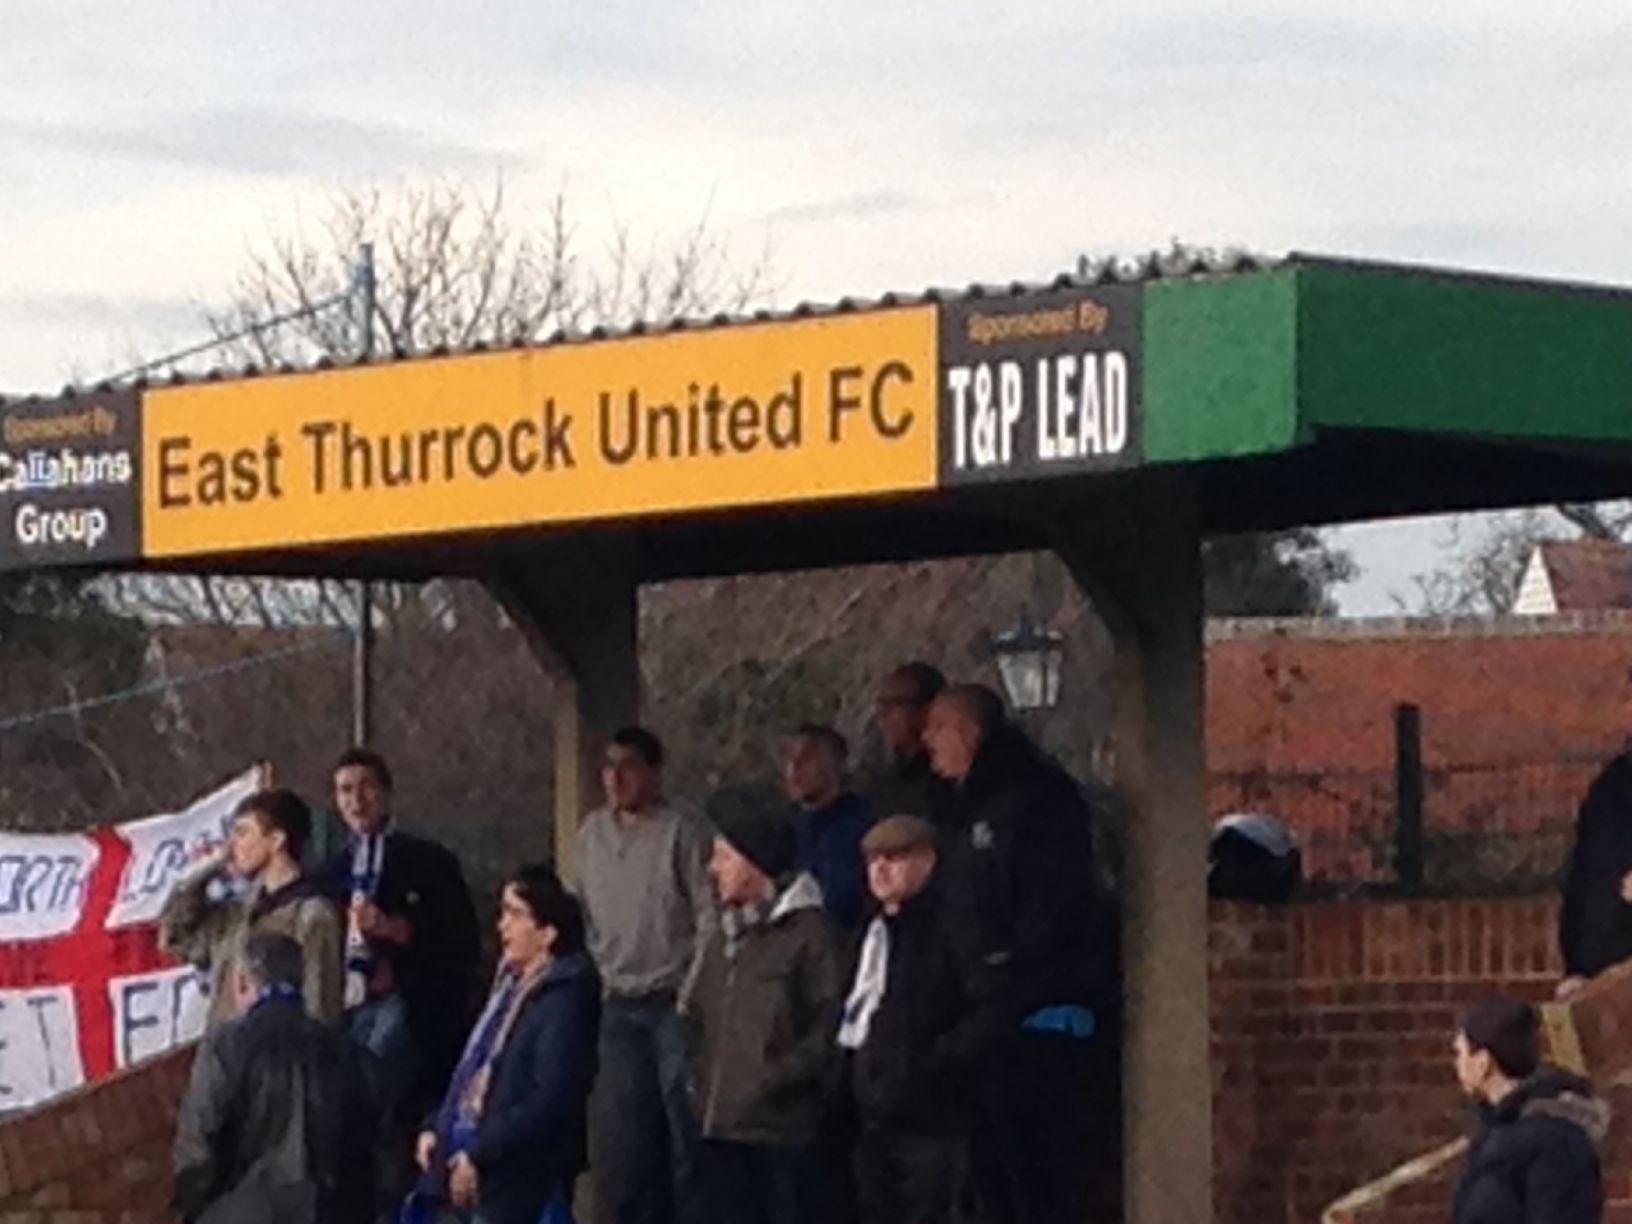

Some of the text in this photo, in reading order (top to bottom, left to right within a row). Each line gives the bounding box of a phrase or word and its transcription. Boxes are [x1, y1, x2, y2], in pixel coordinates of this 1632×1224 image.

[157, 359, 914, 510] East Thurrock United FC
[948, 351, 1128, 468] T&P LEAD
[15, 503, 108, 548] Group
